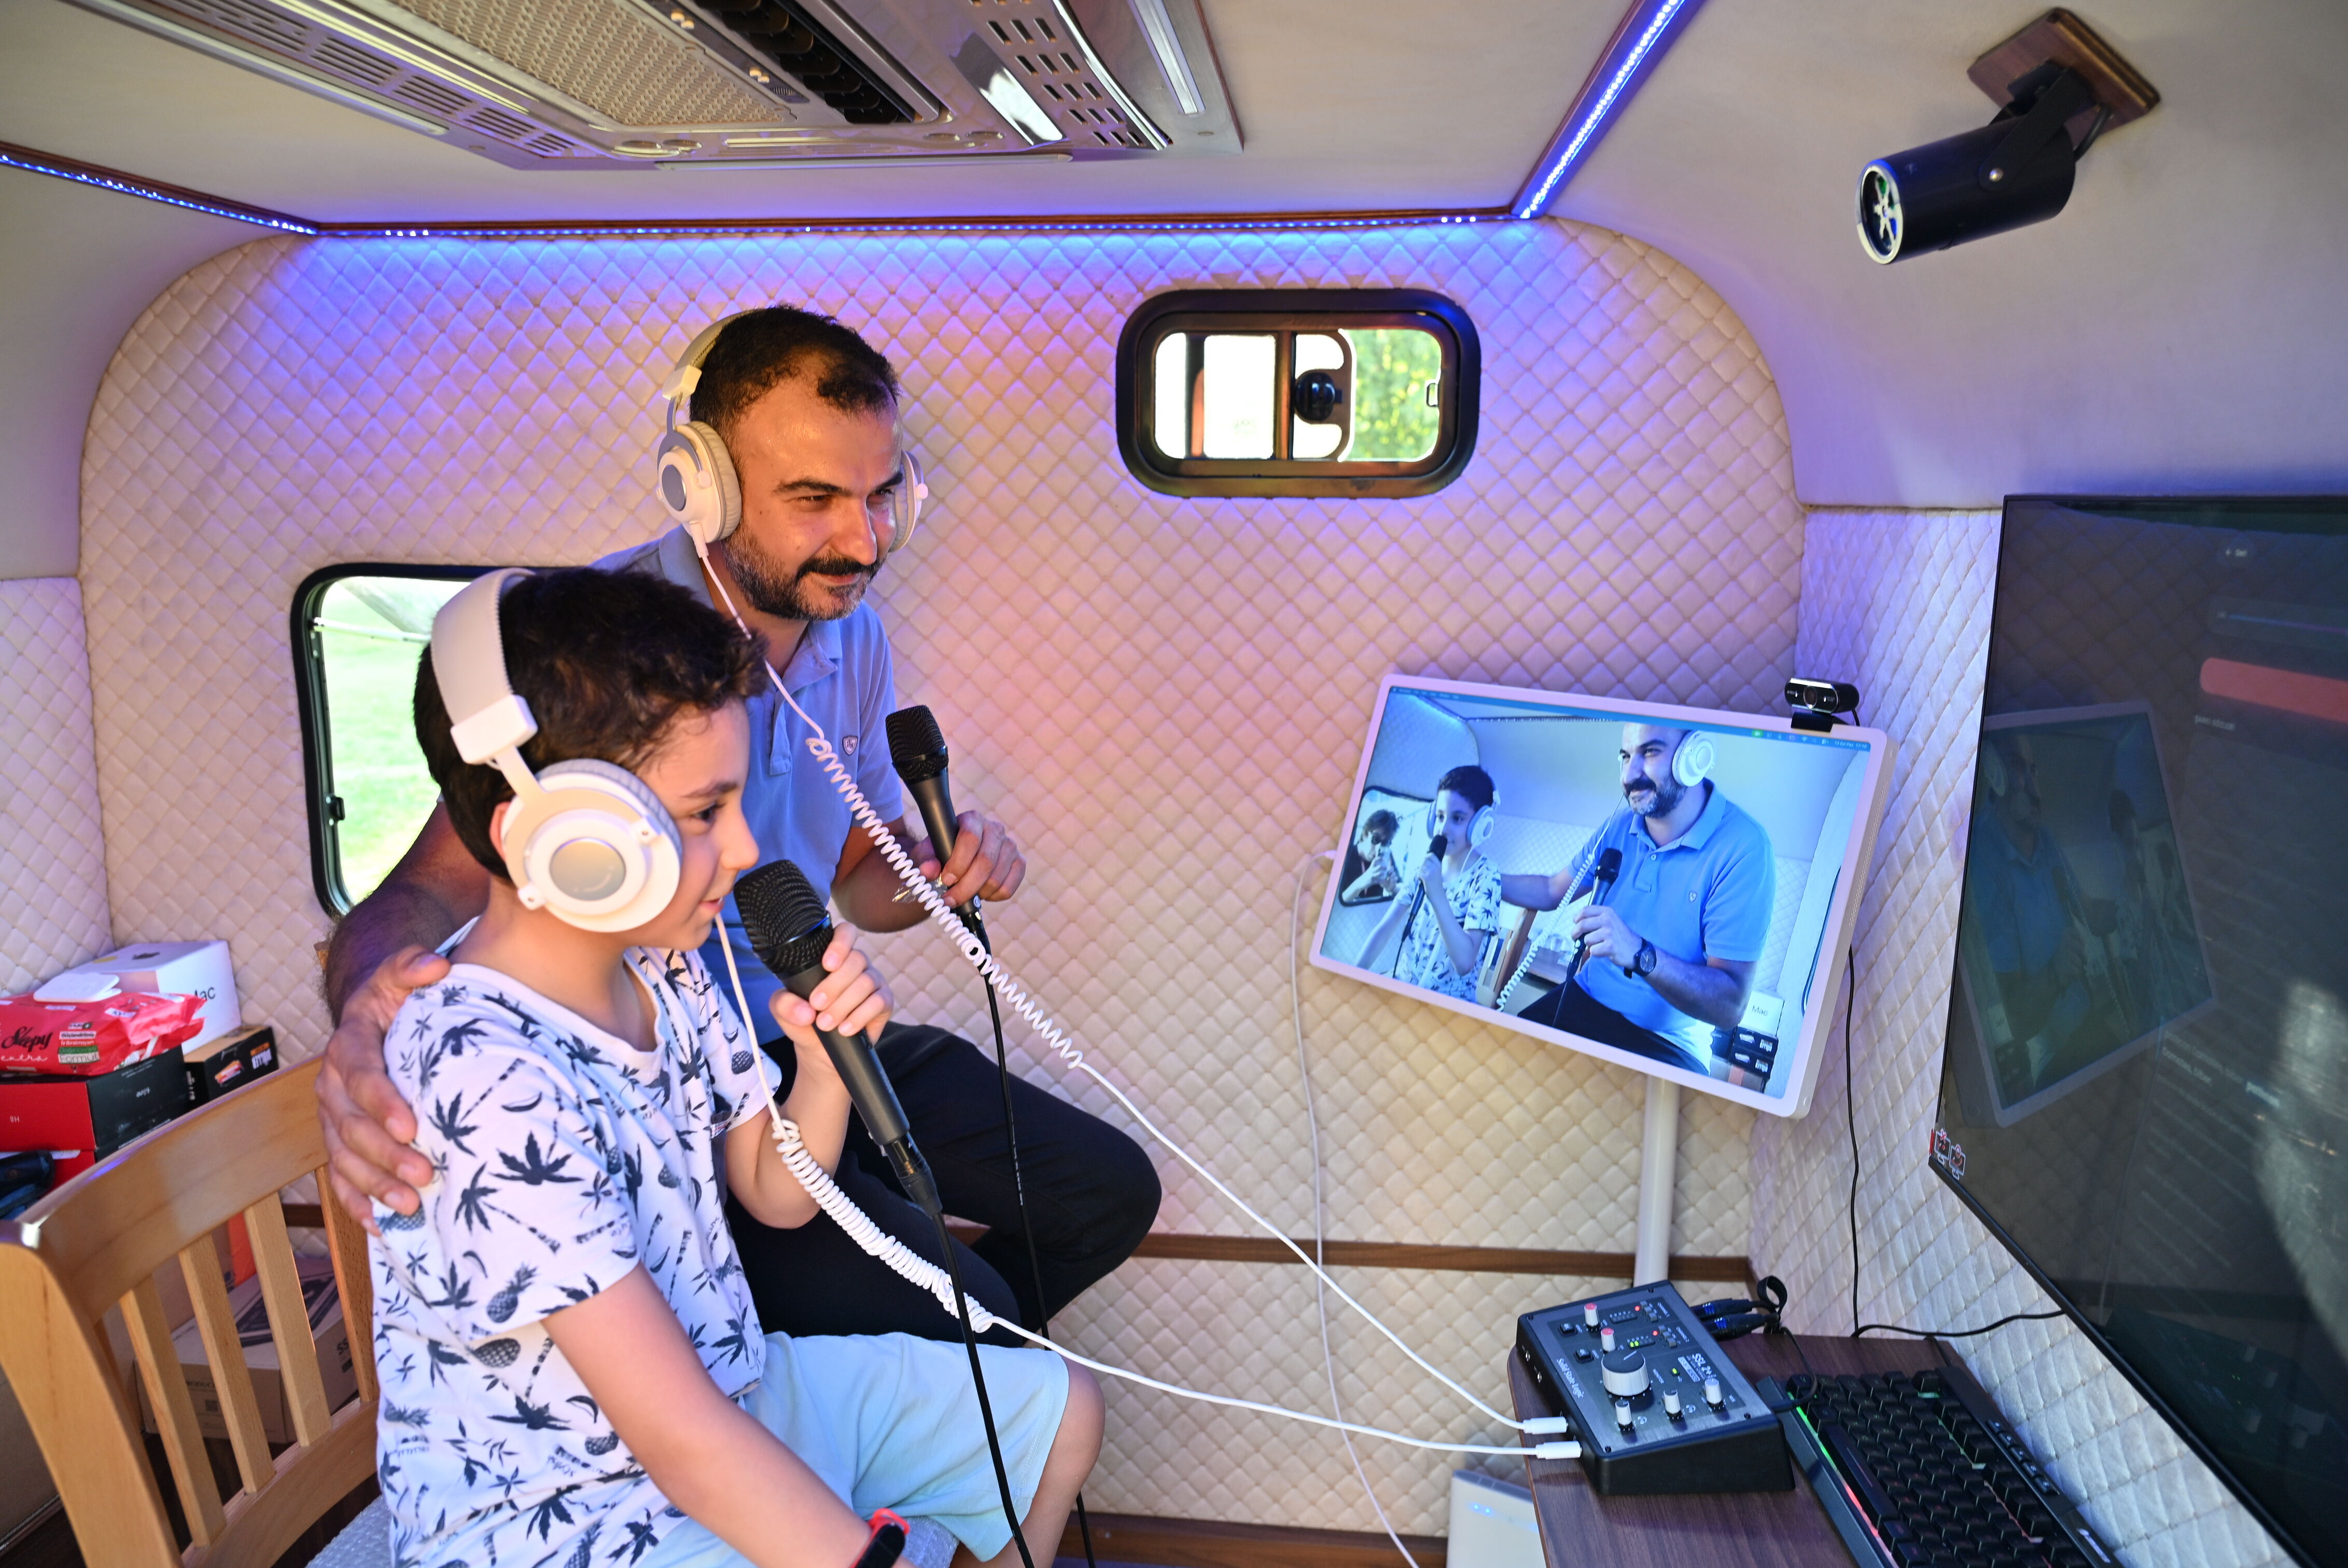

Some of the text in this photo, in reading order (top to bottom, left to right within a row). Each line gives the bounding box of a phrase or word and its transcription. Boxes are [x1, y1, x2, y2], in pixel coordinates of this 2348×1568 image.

[1752, 1005, 1768, 1016] Mac
[1, 1053, 48, 1061] extra
[1557, 1358, 1570, 1372] Solid
